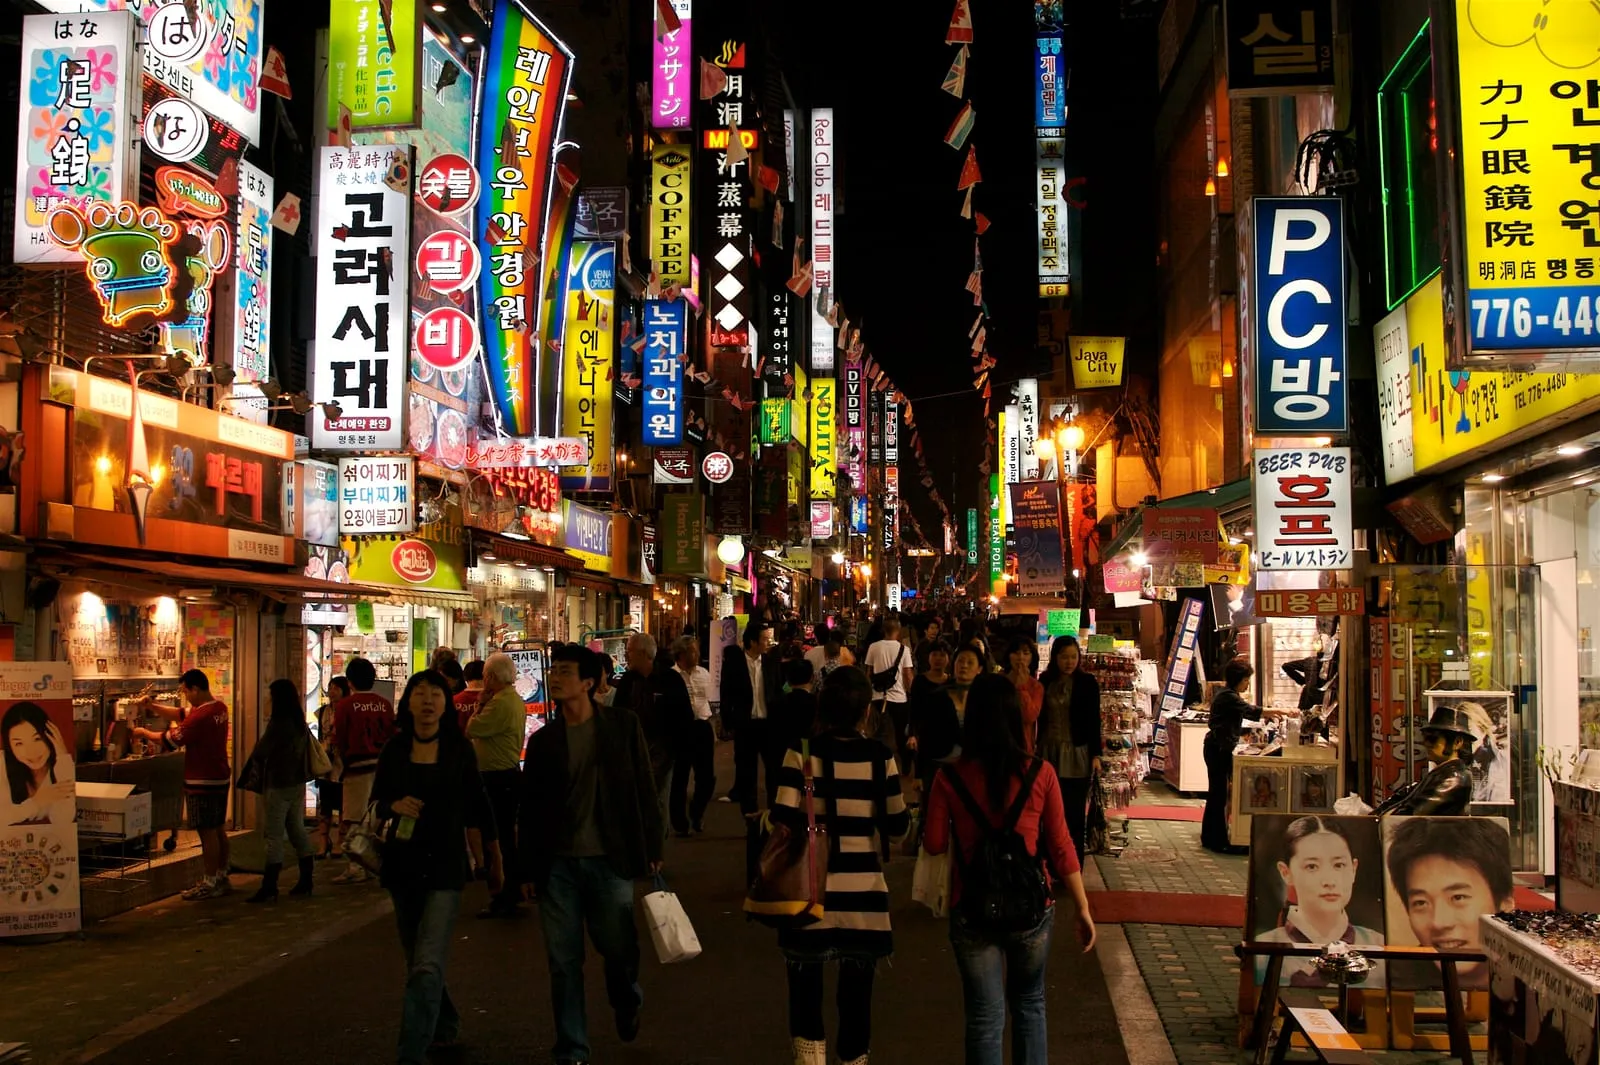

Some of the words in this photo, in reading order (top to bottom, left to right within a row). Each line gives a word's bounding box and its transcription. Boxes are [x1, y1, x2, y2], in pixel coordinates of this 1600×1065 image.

[54, 19, 98, 40] はな
[162, 15, 191, 45] は
[1036, 37, 1063, 55] 명동
[1040, 55, 1058, 122] 게임랜드
[672, 116, 688, 127] 3F
[815, 119, 831, 147] Red
[708, 131, 755, 149] MD
[815, 152, 831, 188] Club
[1479, 79, 1536, 248] カナ眼鏡院
[246, 170, 267, 198] はな
[335, 172, 388, 187] 炭火燒
[422, 166, 473, 199] 숯불
[658, 173, 684, 275] COFFEE
[1041, 205, 1058, 270] 정통맥주
[593, 270, 612, 279] VIENNA
[1479, 260, 1537, 281] 明洞店
[1546, 258, 1600, 280] 명동
[590, 279, 612, 289] OPTICAL
[1046, 285, 1062, 296] 6F
[330, 192, 393, 410] 고려시대
[1267, 208, 1342, 421] PC방
[1471, 296, 1600, 339] 776-44
[1075, 348, 1108, 362] Java
[502, 342, 523, 404] メガネ
[647, 305, 681, 439] 노치과의원
[1087, 360, 1117, 376] City
[848, 370, 859, 425] DVD방
[1471, 378, 1499, 428] 안경원
[1514, 391, 1526, 411] TEL
[1528, 372, 1567, 404] 776-4480
[368, 418, 388, 431] 환영
[815, 386, 831, 468] NOLITA
[338, 434, 376, 446] 명동본점
[343, 462, 408, 482] 섞어찌개
[662, 459, 691, 475] 본죽
[706, 457, 728, 474] 粥
[1258, 451, 1302, 475] BEER
[1308, 451, 1347, 474] PUB
[343, 485, 408, 504] 부대찌개
[343, 507, 408, 528] 오징어불고기
[1274, 474, 1339, 546] 호프
[991, 518, 1000, 544] BEAN
[1147, 528, 1215, 544] 스티커사진
[991, 547, 1000, 573] POLE
[1261, 549, 1349, 567] ビールレストラン
[1261, 592, 1339, 614] 미용실
[1342, 591, 1360, 612] 3F
[512, 651, 539, 663] 려시대
